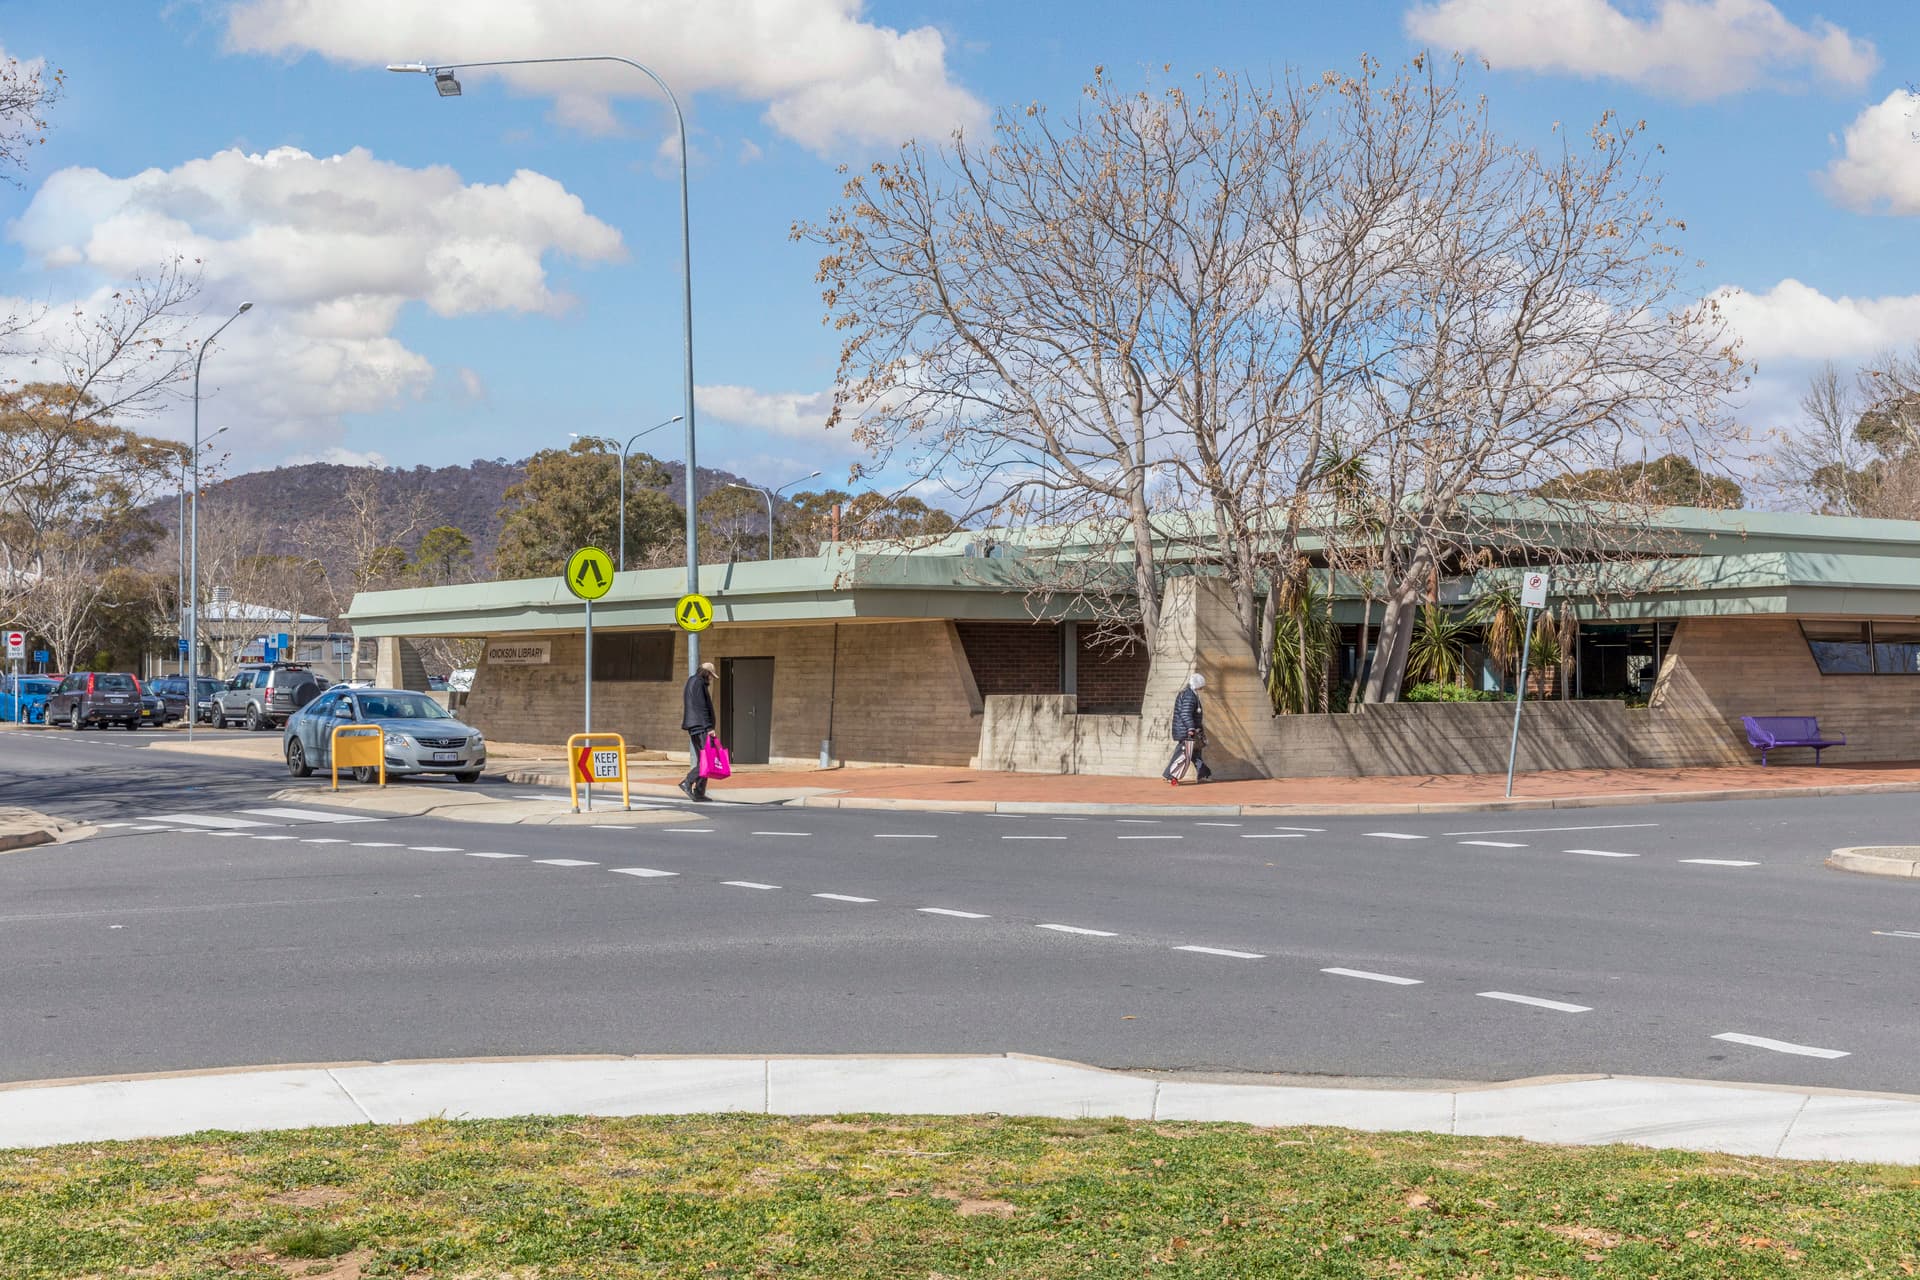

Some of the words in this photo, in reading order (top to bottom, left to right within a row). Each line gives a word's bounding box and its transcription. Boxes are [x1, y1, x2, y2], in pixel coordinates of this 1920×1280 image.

[491, 648, 517, 658] DICKSON
[518, 647, 544, 657] LIBRARY
[595, 753, 617, 763] KEEP
[596, 766, 617, 776] LEFT
